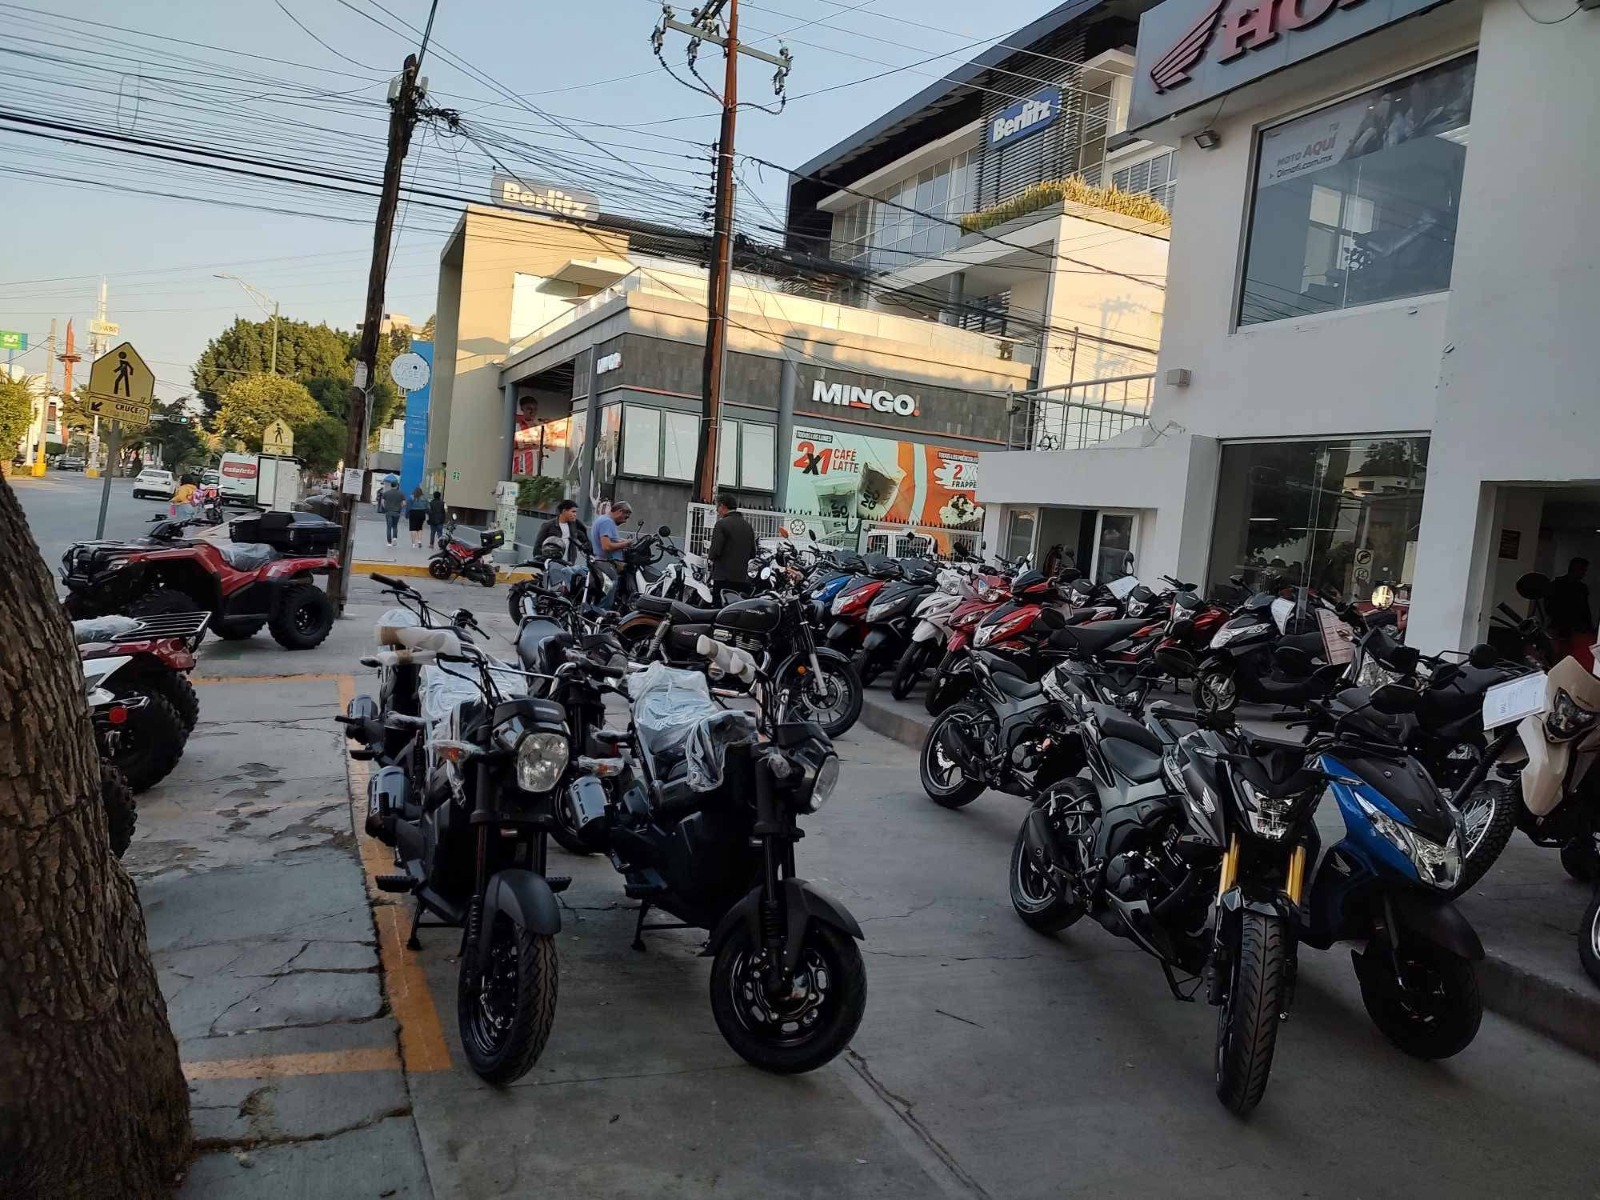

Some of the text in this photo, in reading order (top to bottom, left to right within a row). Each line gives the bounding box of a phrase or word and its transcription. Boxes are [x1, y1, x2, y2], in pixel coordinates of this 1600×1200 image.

[993, 100, 1051, 142] Berlitz
[1277, 152, 1302, 166] MOTO
[503, 182, 588, 218] Berlitz
[115, 403, 139, 414] CRUCE
[833, 448, 858, 462] CAFÉ
[223, 466, 256, 475] estafeta
[832, 460, 860, 474] LATTE
